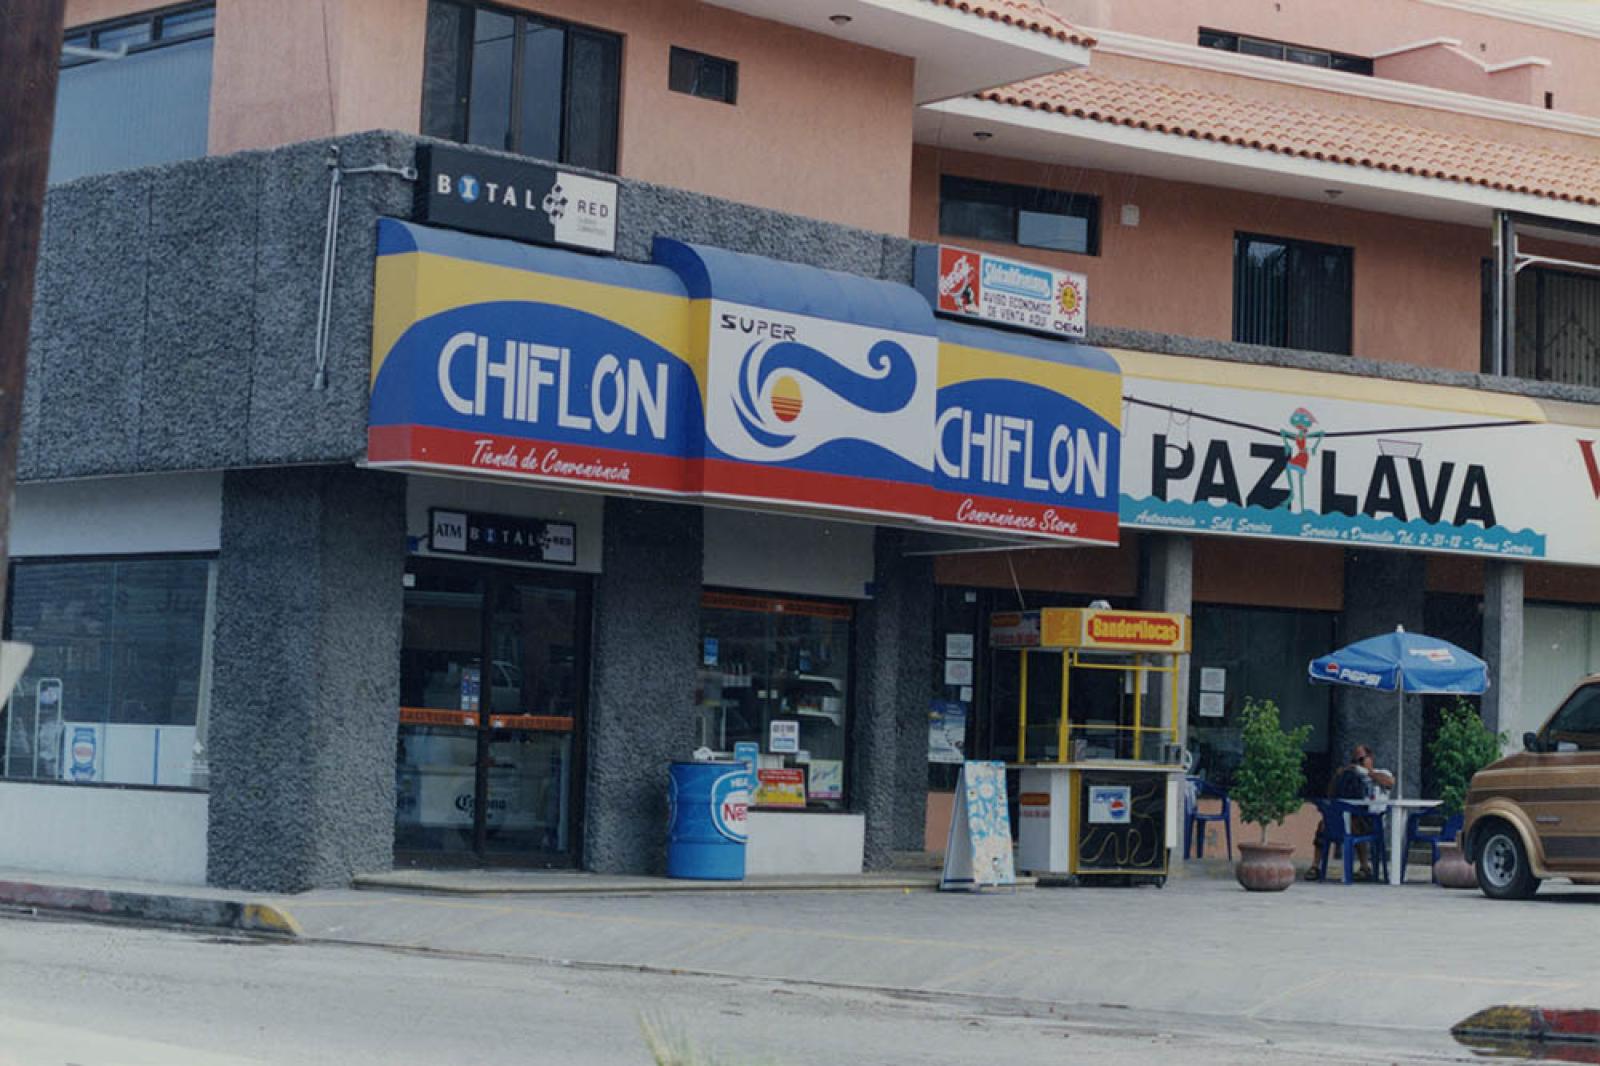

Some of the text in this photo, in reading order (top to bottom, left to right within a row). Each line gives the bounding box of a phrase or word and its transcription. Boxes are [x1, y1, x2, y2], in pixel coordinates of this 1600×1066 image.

[437, 173, 536, 210] BITAL
[577, 199, 609, 218] RED
[720, 313, 796, 342] SUPER
[437, 332, 669, 440] CHIFLON
[471, 439, 630, 481] Tienda de Conveniencia
[935, 406, 1108, 499] CHIFLON
[1153, 434, 1291, 510] PAZ
[1321, 450, 1496, 529] LAVA
[435, 522, 463, 539] ATM
[956, 498, 1078, 534] Convenience Store
[470, 526, 535, 547] BITAL
[1340, 668, 1382, 686] PEPSI
